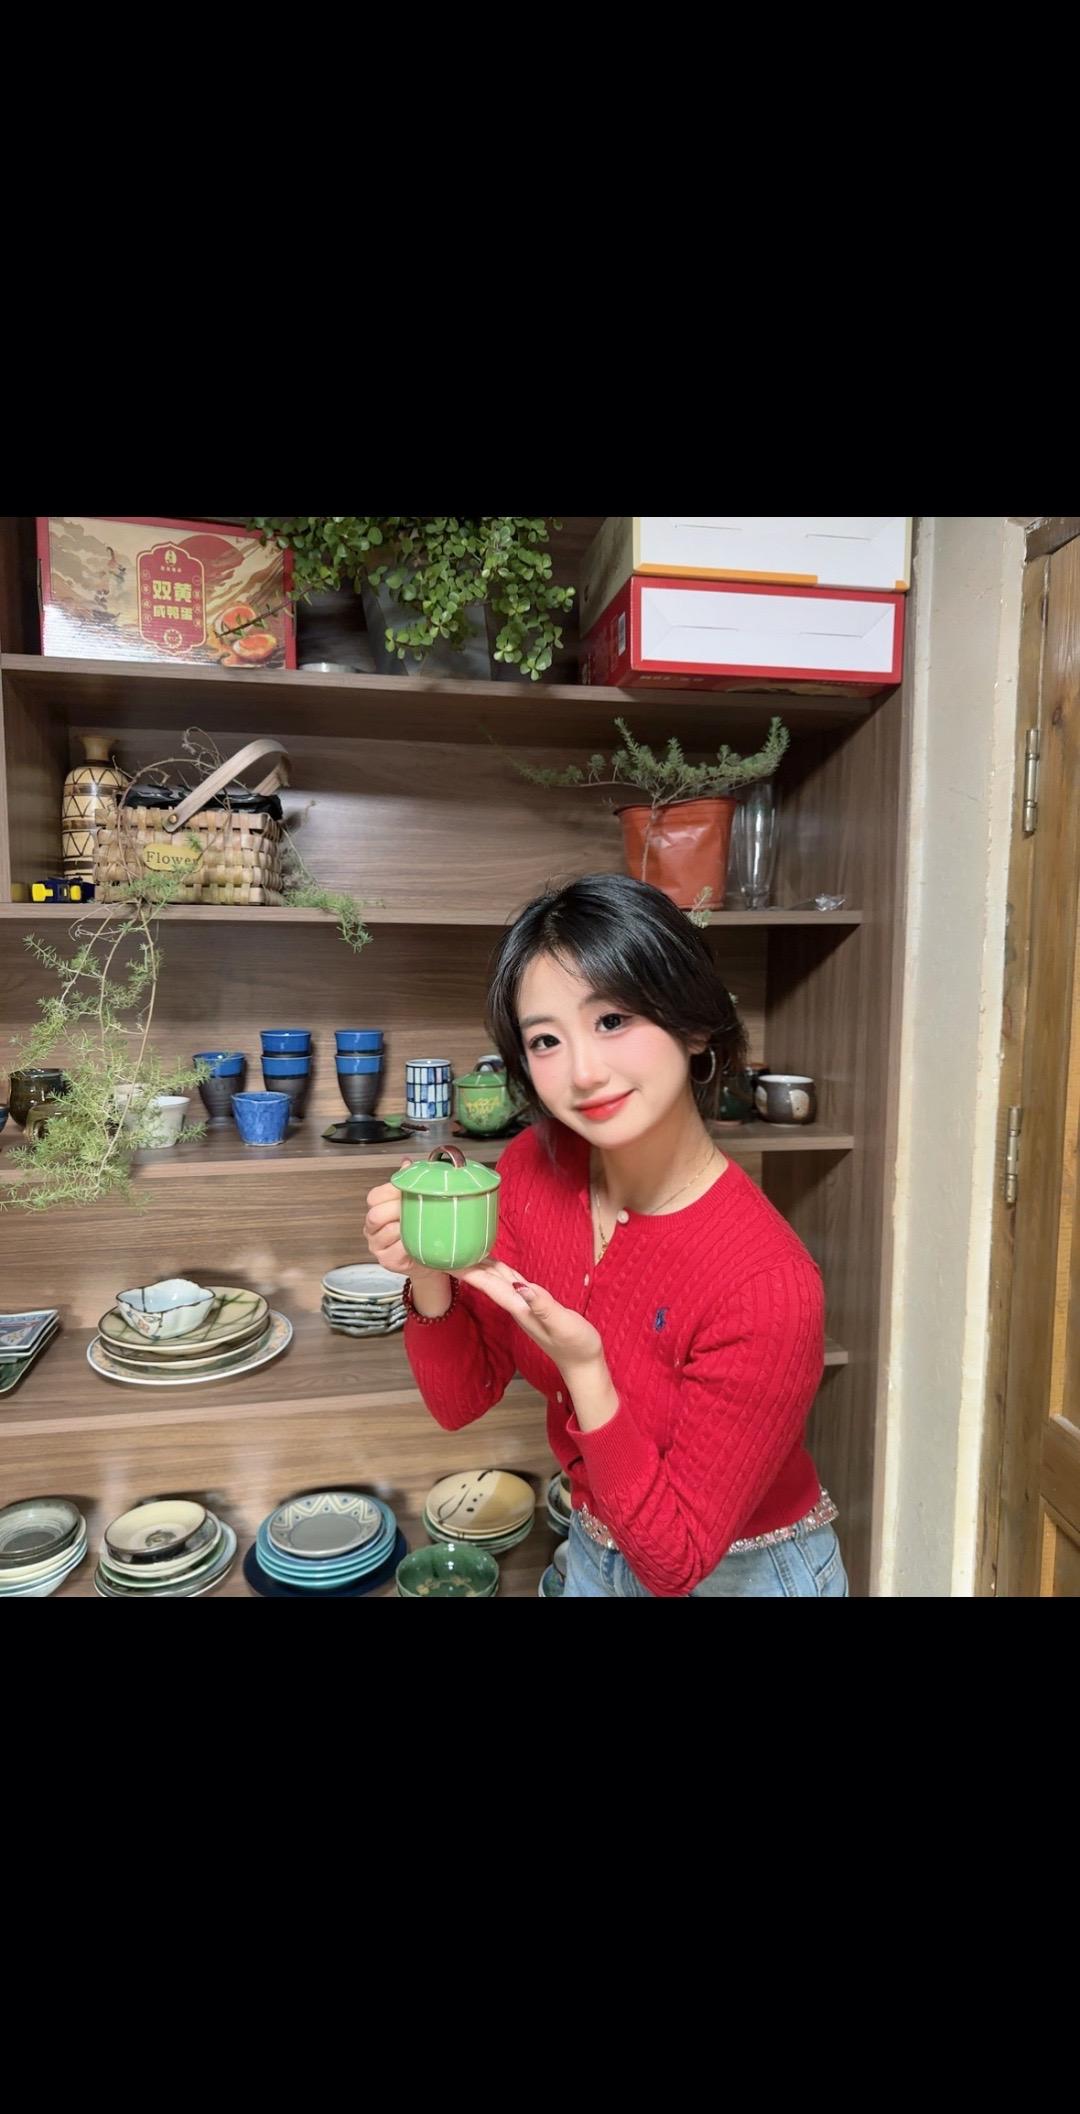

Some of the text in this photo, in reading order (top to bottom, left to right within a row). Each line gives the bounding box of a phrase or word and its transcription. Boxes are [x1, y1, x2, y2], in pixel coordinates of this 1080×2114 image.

[152, 580, 192, 603] 双黄
[153, 605, 193, 620] 咸鸭蛋
